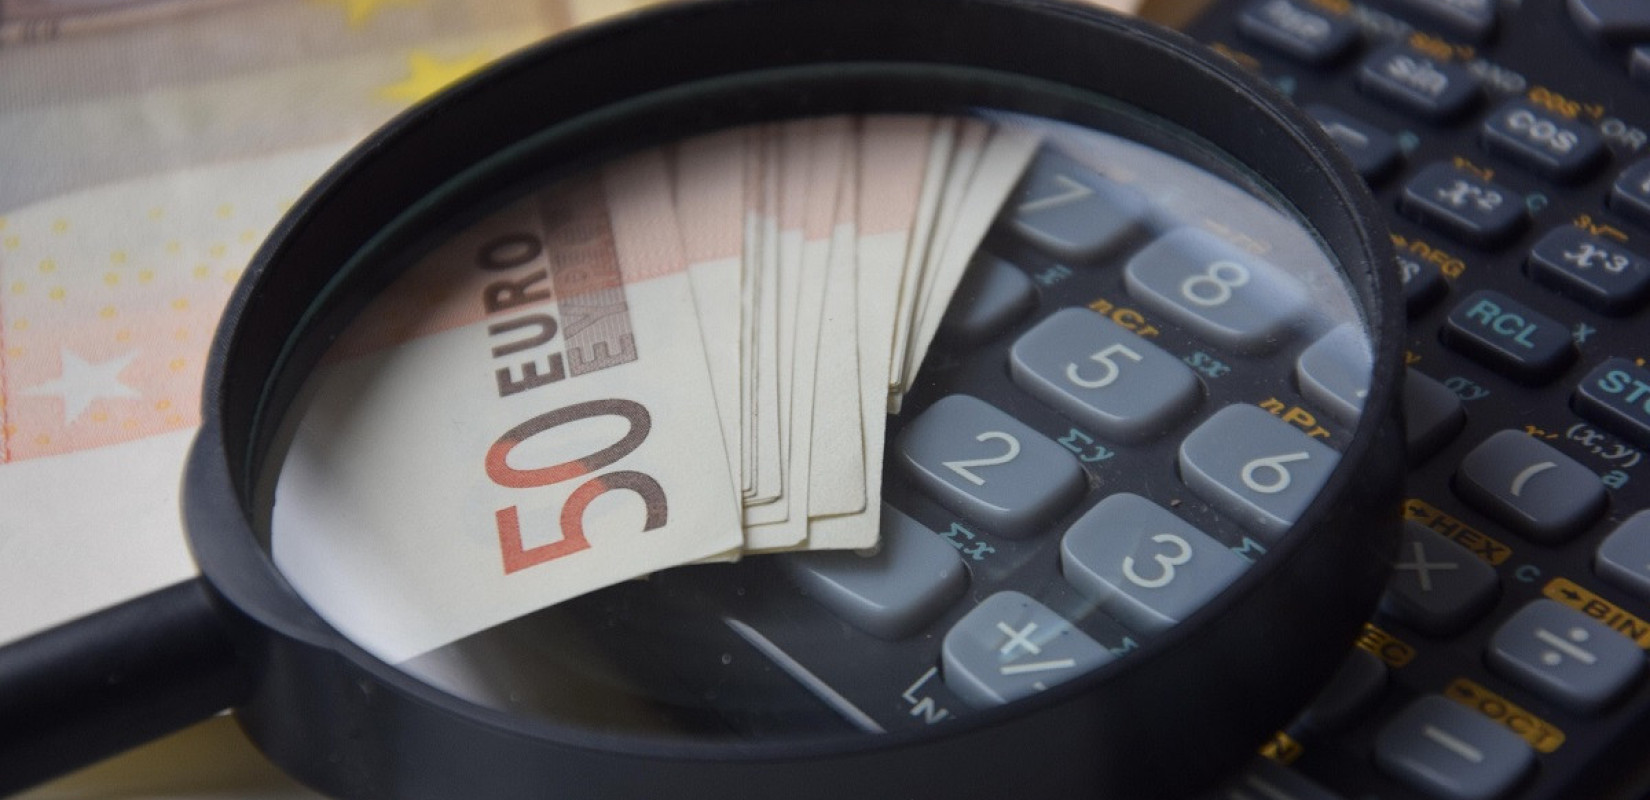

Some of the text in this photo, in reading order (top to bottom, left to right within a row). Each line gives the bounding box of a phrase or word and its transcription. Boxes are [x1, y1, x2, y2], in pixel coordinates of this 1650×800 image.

[1506, 108, 1579, 154] cos
[1018, 173, 1094, 214] 7
[1181, 260, 1252, 306] 8
[477, 231, 568, 398] EURO
[1087, 297, 1160, 338] nCr
[1465, 298, 1537, 350] RCL
[1066, 343, 1144, 389] 5
[1258, 396, 1332, 440] nPr
[941, 430, 1021, 487] 2
[1240, 451, 1310, 495] 6
[484, 397, 669, 577] 50
[1121, 533, 1194, 589] 3
[1426, 516, 1507, 562] HEX
[1583, 600, 1648, 641] BIN
[1480, 699, 1557, 746] OCT
